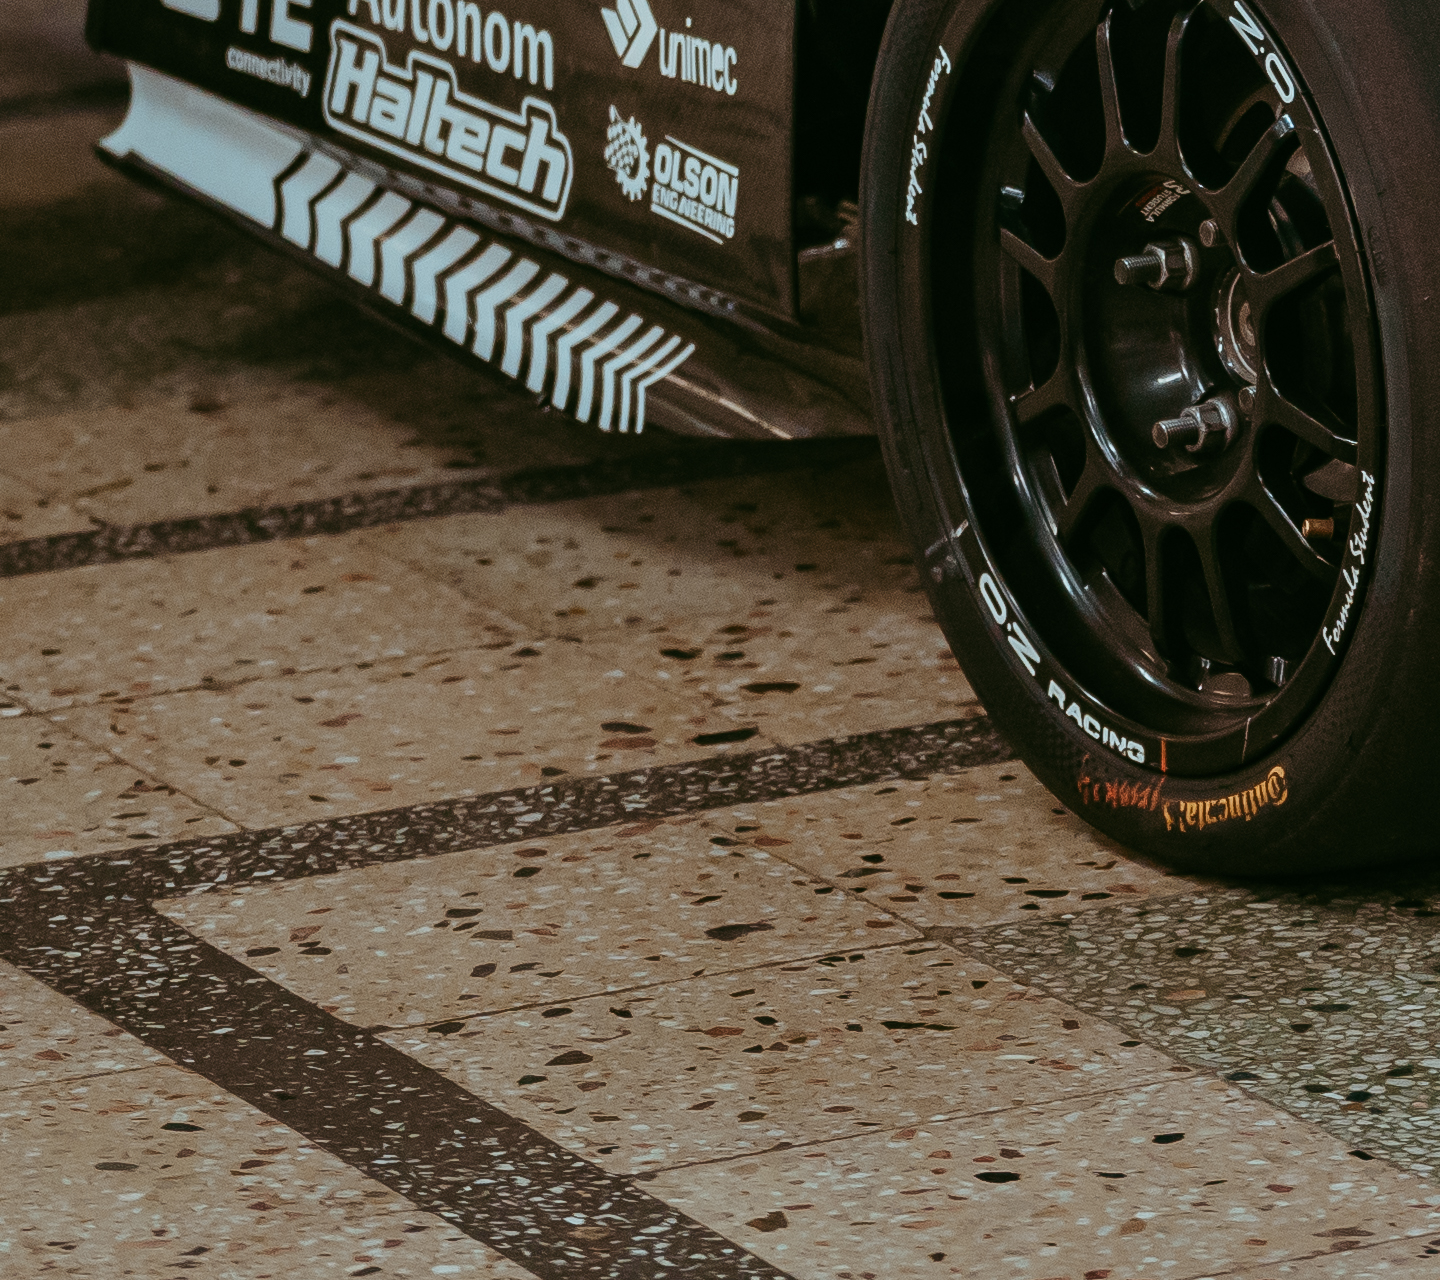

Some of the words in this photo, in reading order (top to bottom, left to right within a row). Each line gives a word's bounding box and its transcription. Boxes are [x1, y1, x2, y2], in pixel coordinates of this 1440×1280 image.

[226, 46, 311, 98] connectivity
[659, 17, 738, 96] unimec
[331, 36, 564, 207] Haltech
[652, 141, 739, 217] OLSON
[652, 183, 736, 239] ENGINEERING
[1323, 565, 1360, 656] Formula
[1350, 469, 1375, 566] Student
[1047, 679, 1146, 765] RACING
